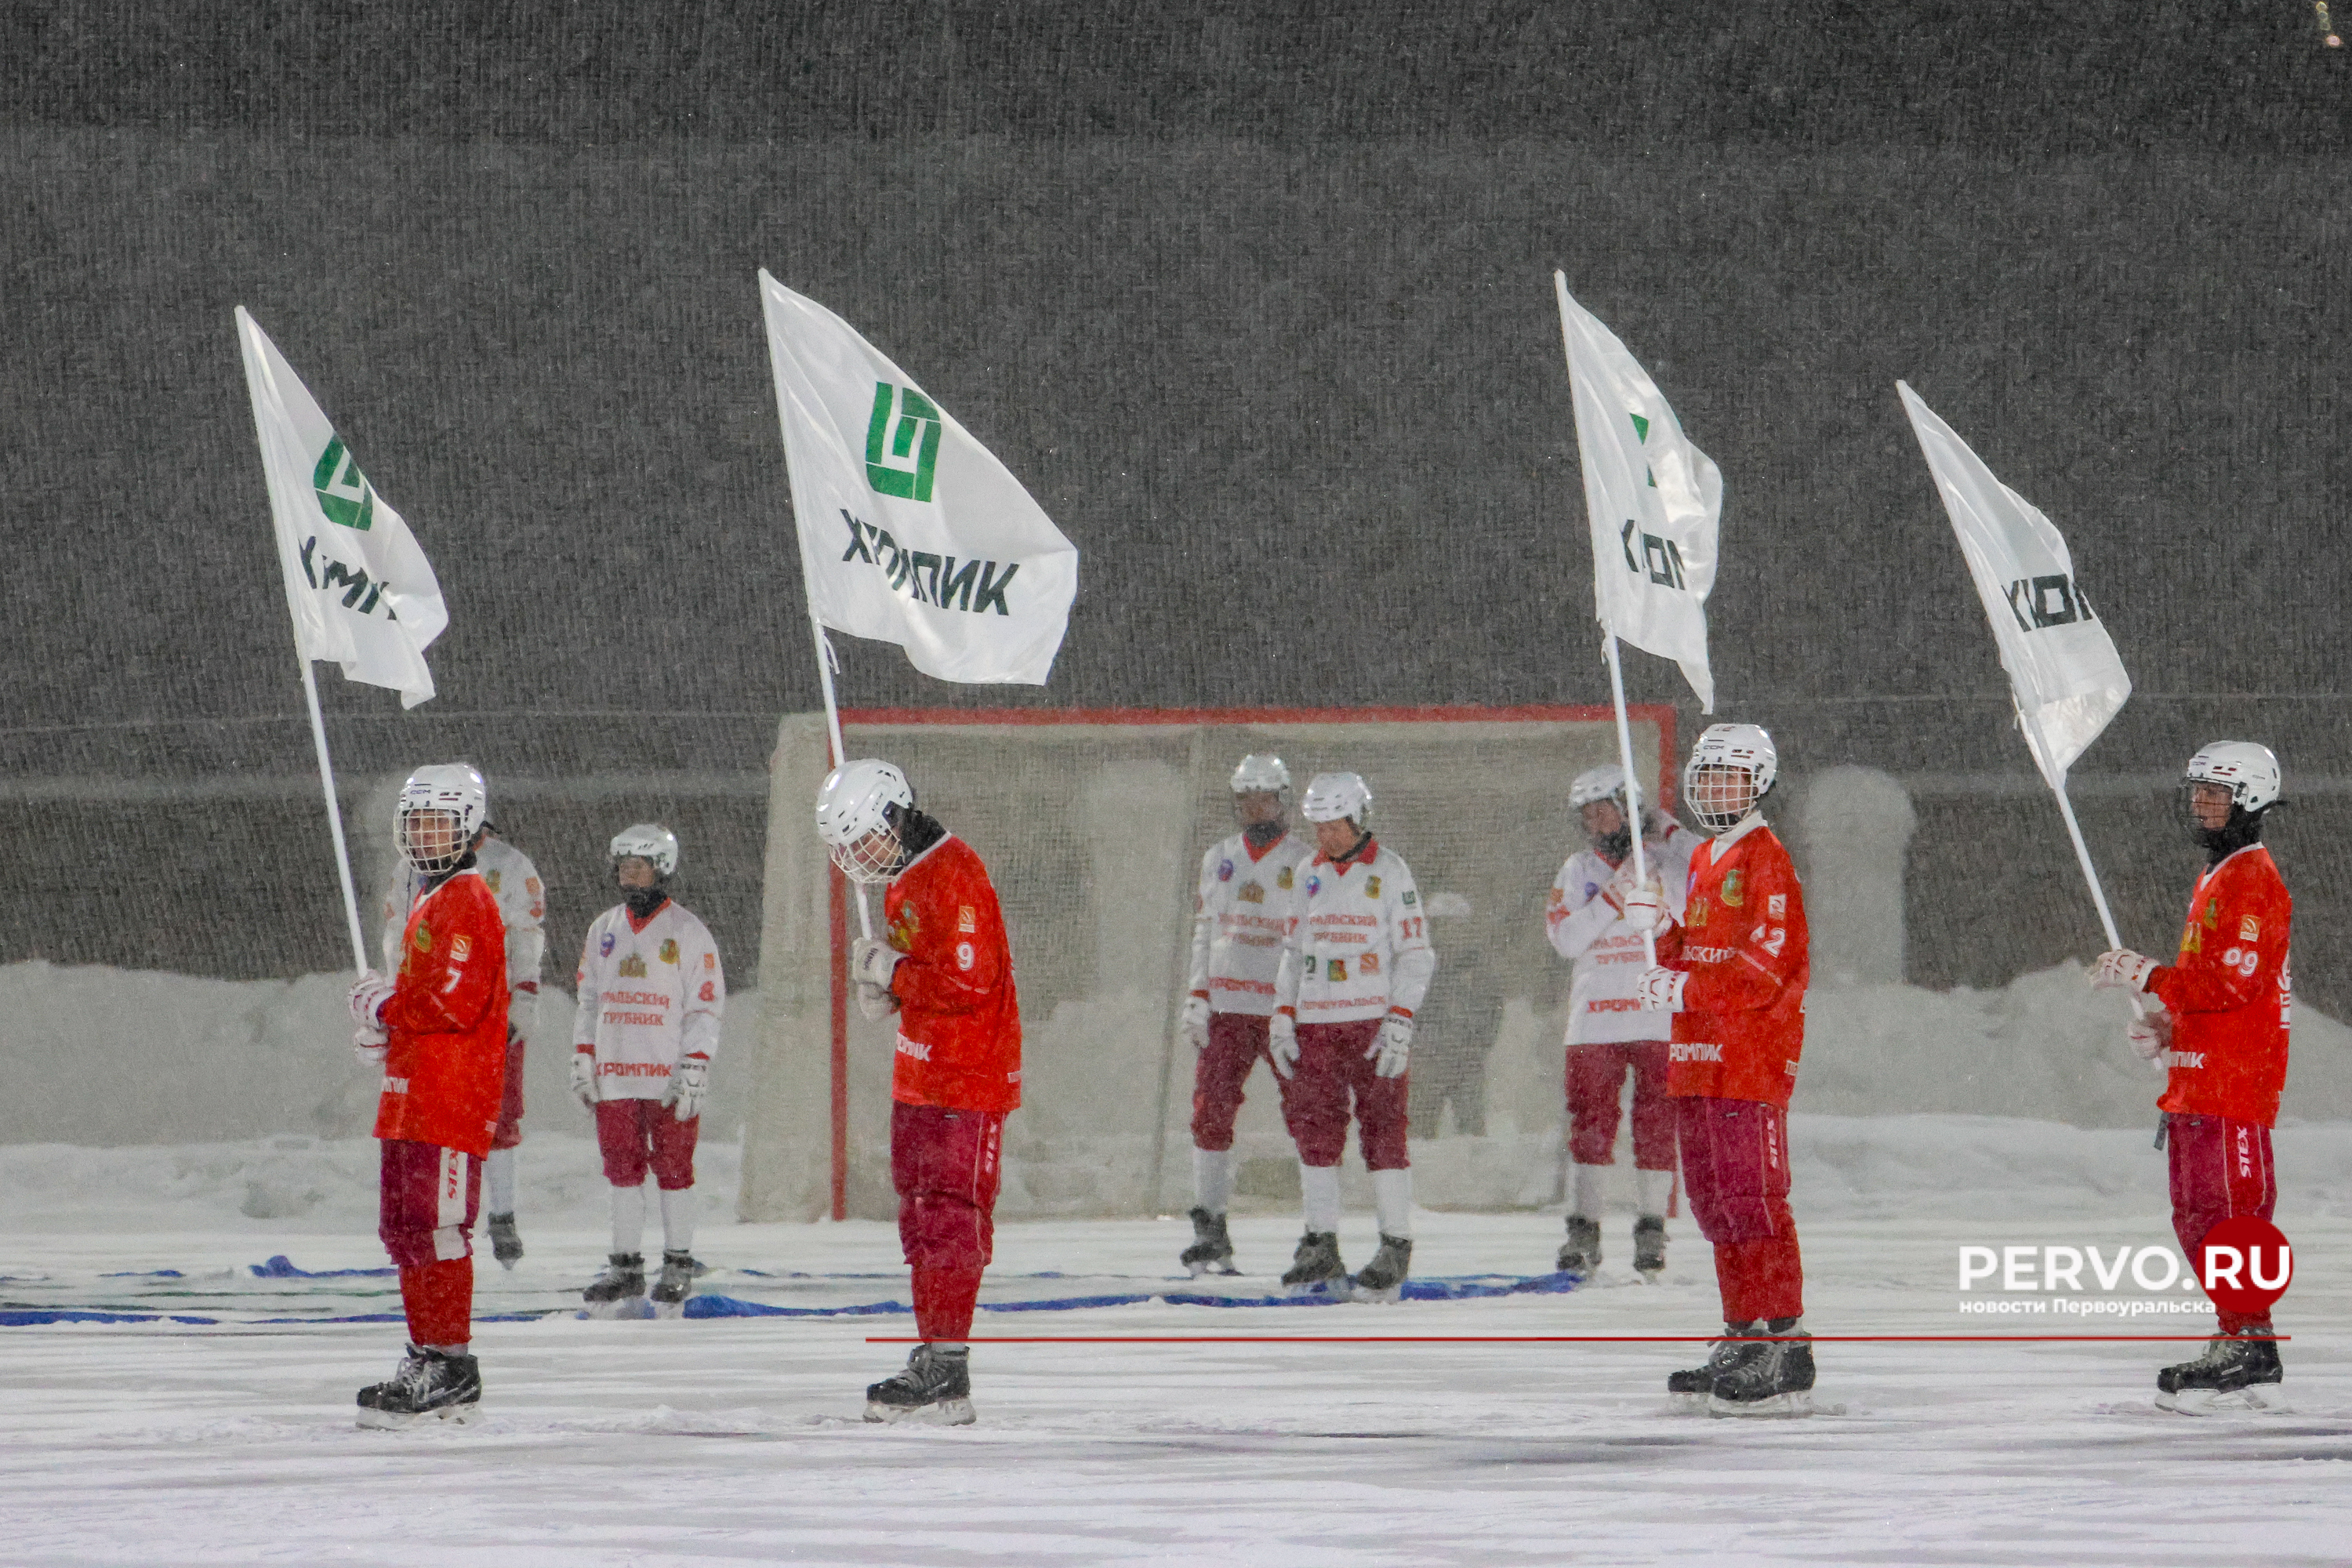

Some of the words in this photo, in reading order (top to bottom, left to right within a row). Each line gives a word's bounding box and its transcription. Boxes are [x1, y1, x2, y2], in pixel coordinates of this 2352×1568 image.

[955, 941, 975, 971] 9
[441, 966, 463, 994] 7
[1669, 1043, 1724, 1062] РОМПИК
